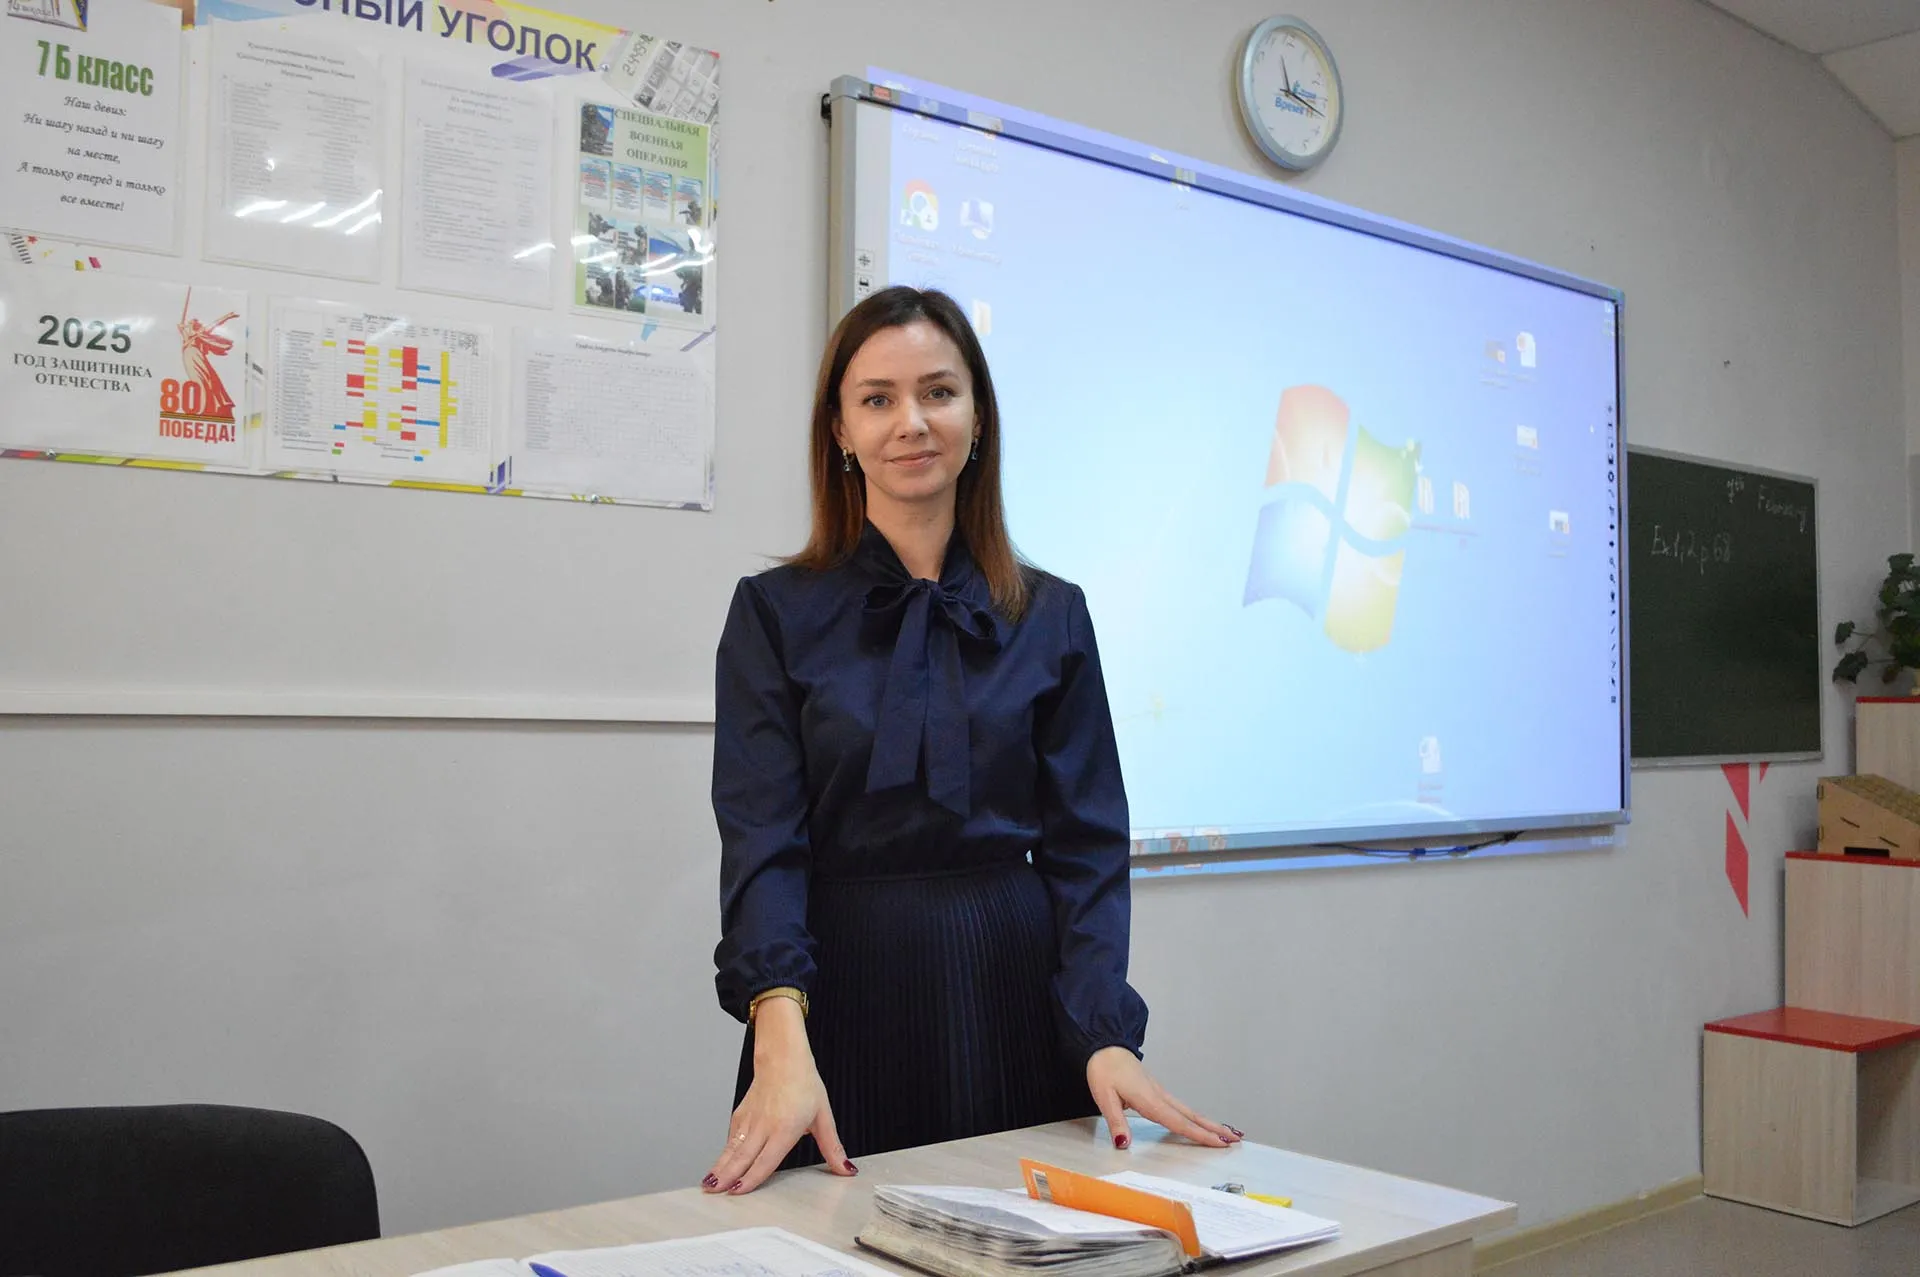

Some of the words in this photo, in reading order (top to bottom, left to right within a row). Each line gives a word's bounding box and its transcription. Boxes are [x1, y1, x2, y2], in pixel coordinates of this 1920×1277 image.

[438, 5, 597, 72] УГОЛОК
[78, 54, 153, 96] класс
[64, 96, 91, 109] Наш
[23, 113, 42, 125] Ни
[45, 119, 73, 133] шагу
[76, 124, 108, 137] назад
[111, 130, 118, 138] и
[121, 133, 134, 141] ни
[138, 136, 164, 149] шагу
[614, 108, 701, 137] СПЕЦИАЛЬНАЯ
[67, 147, 80, 156] на
[629, 130, 684, 151] ВОЕННАЯ
[626, 148, 689, 169] ОПЕРАЦИЯ
[16, 161, 28, 172] А
[32, 165, 74, 181] только
[77, 173, 112, 187] вперед
[116, 179, 122, 187] и
[126, 180, 166, 196] только
[60, 194, 77, 204] все
[80, 198, 125, 212] вместе!
[37, 314, 131, 354] 2025
[13, 353, 46, 368] ГОД
[50, 356, 152, 379] ЗАЩИТНИКА
[35, 372, 131, 392] ОТЕЧЕСТВА
[160, 378, 201, 415] 80
[159, 419, 236, 444] ПОБЕДА!
